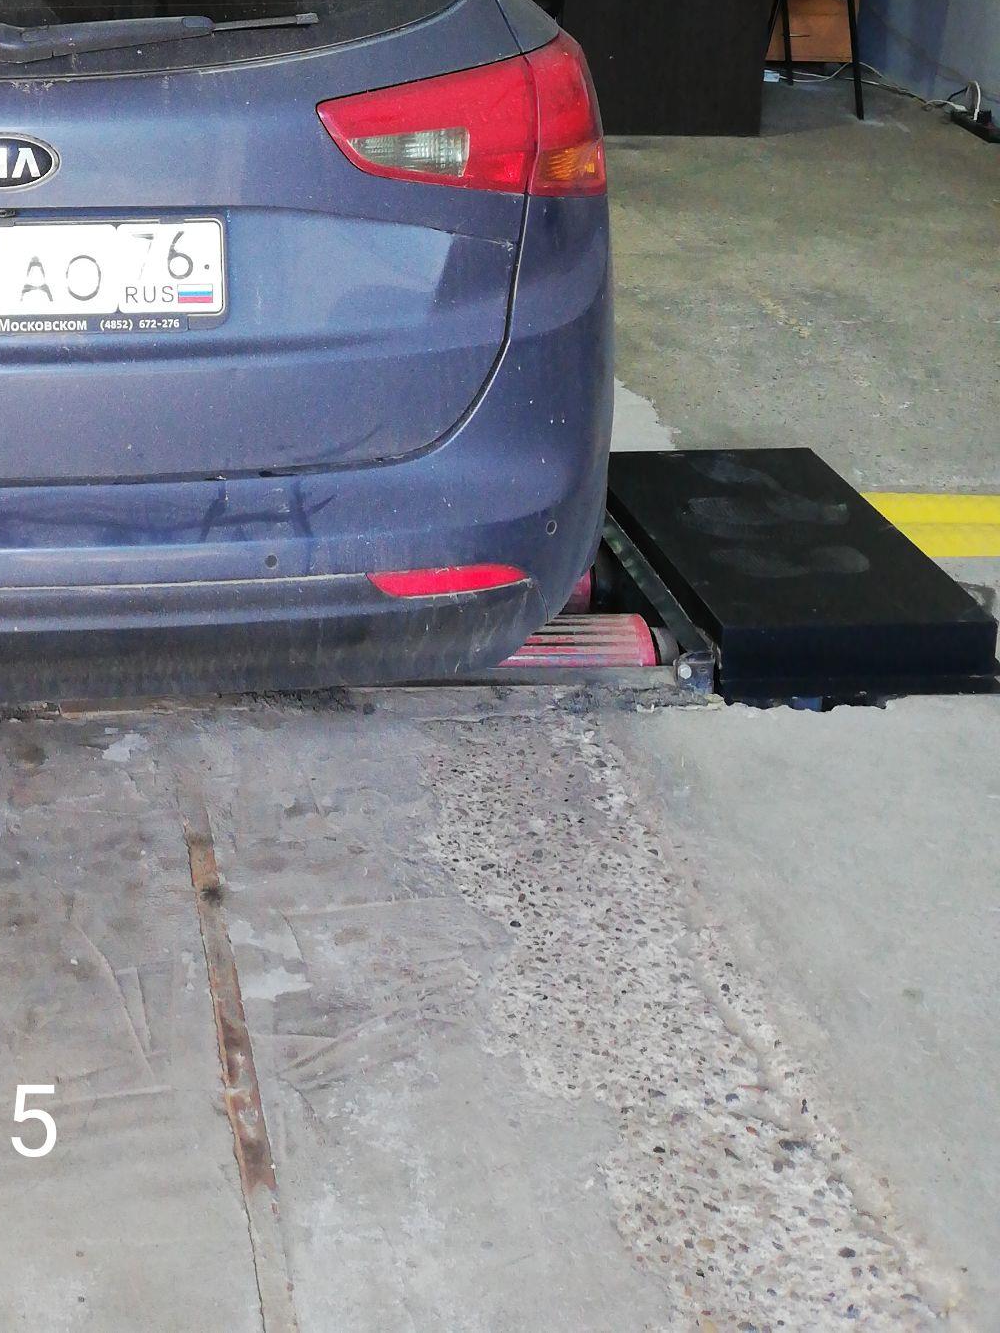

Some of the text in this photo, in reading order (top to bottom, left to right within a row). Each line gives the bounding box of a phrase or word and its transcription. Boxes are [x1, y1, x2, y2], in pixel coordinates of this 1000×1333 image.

[130, 230, 193, 280] 76
[124, 285, 175, 304] RUS
[99, 319, 133, 331] (4852)
[139, 318, 180, 329] 672-276
